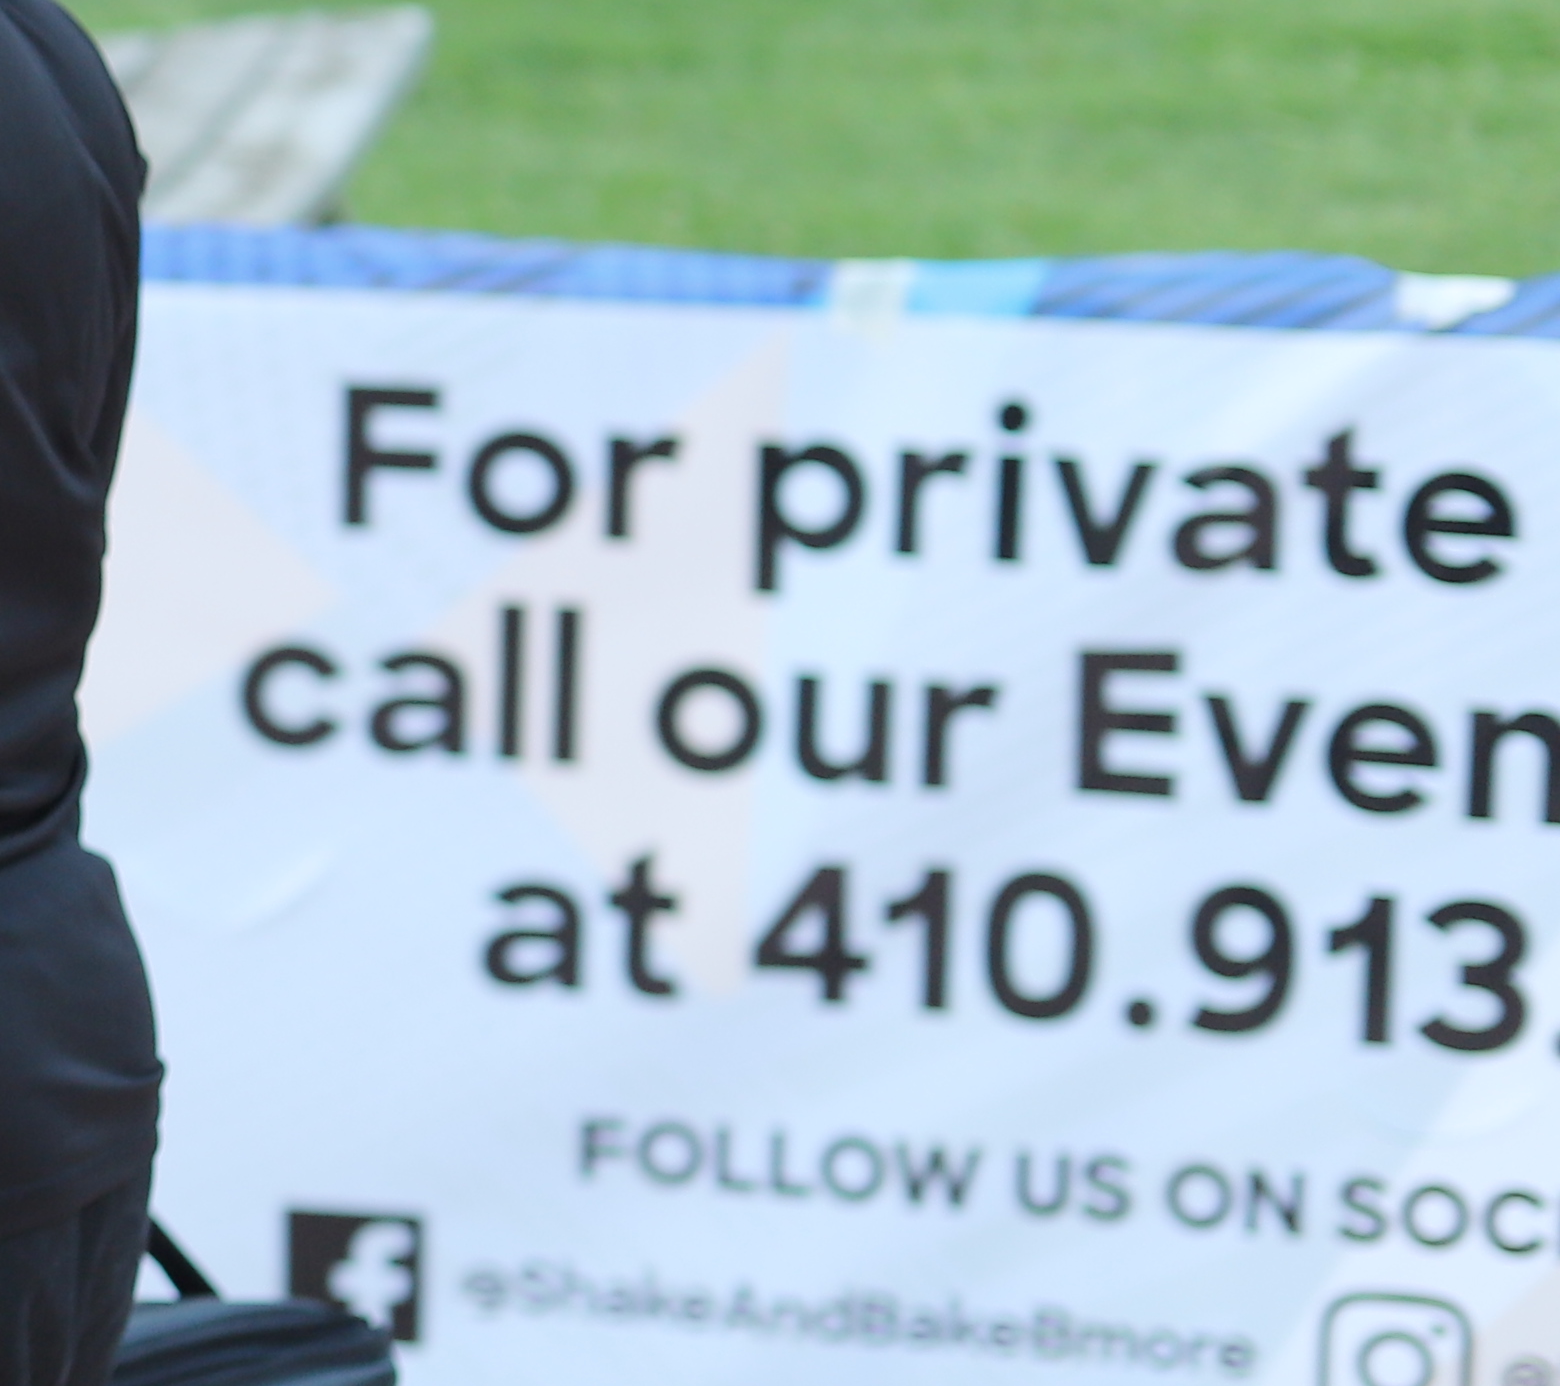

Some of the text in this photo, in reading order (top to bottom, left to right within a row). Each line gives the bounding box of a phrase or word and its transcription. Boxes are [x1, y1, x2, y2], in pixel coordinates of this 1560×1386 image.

[340, 382, 1519, 595] For private
[237, 602, 1560, 827] call our Even
[480, 854, 1560, 1056] at 410.913
[576, 1115, 1560, 1259] FOLLOW US ON SOC
[457, 1260, 1259, 1379] @ShakeAndBakeBmore
